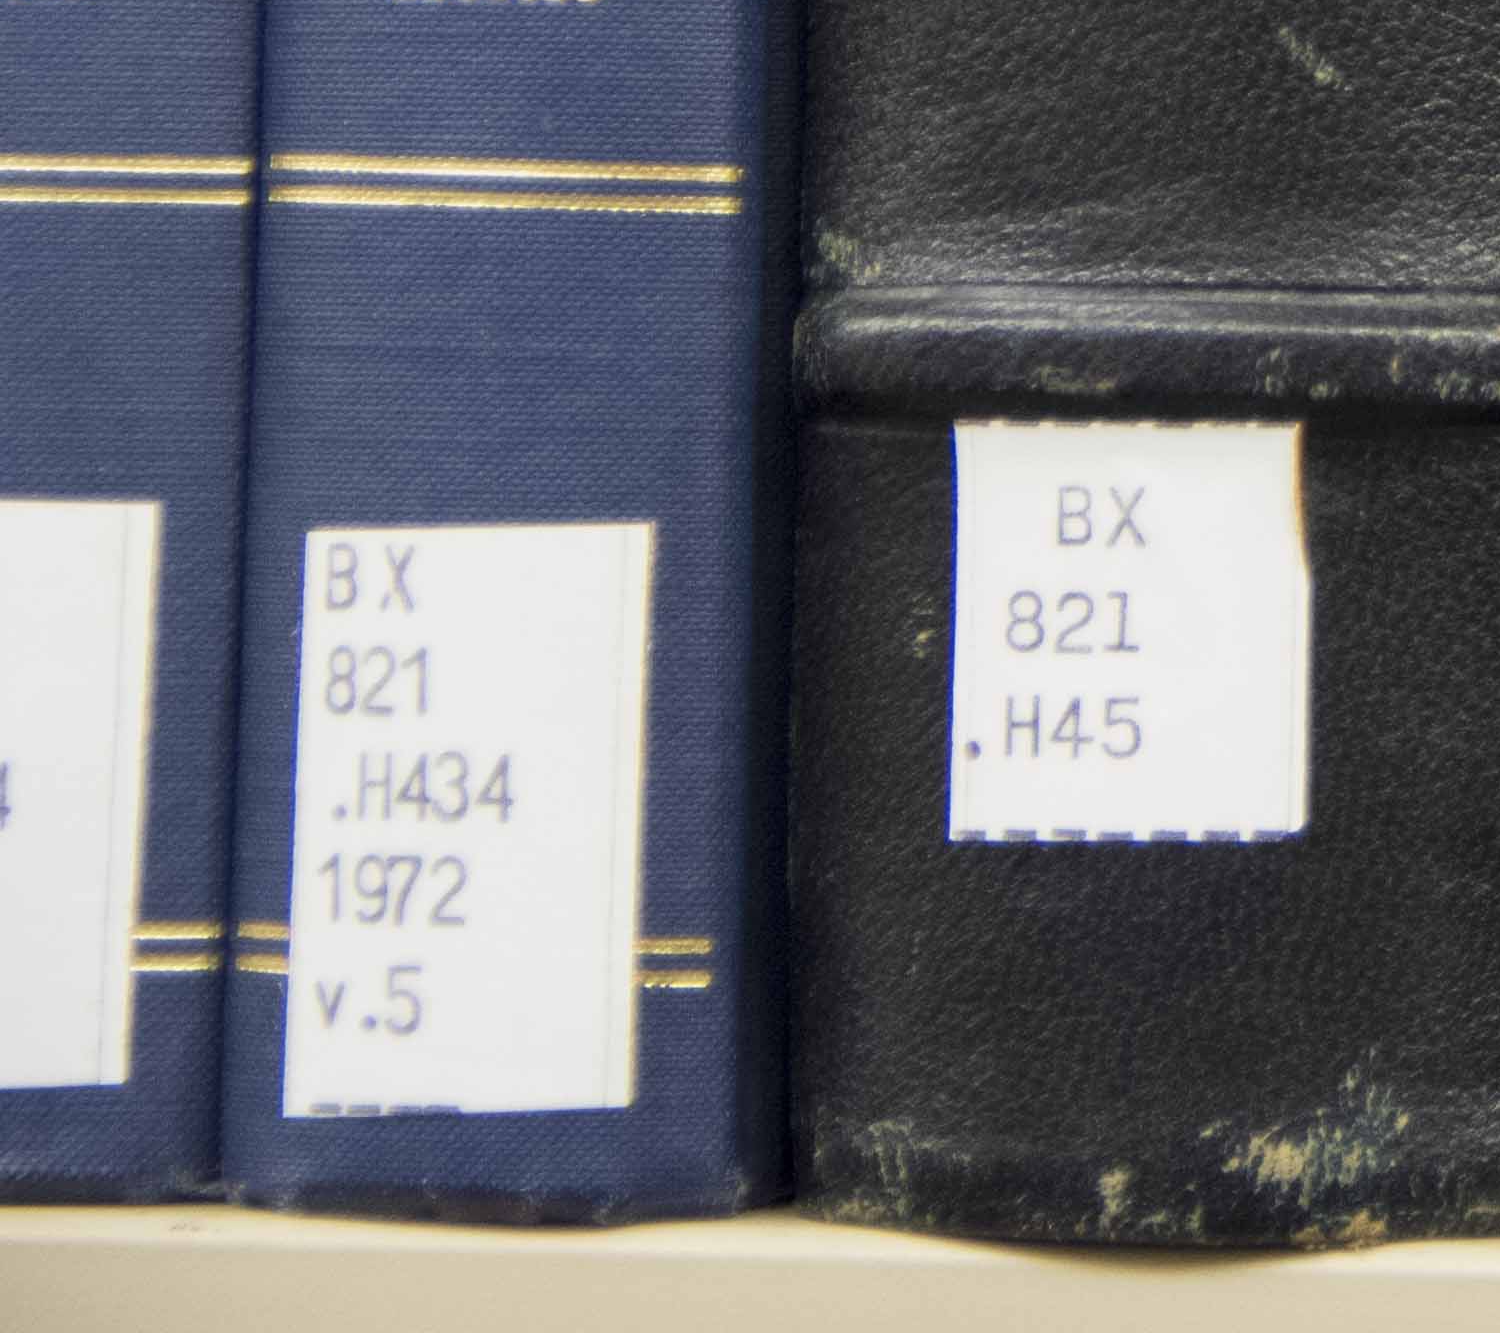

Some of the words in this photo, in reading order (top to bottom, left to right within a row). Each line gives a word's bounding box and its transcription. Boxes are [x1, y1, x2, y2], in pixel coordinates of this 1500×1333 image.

[1056, 483, 1150, 549] BX
[1004, 589, 1144, 657] 821
[322, 646, 433, 715] 821
[329, 753, 517, 826] .H434
[316, 856, 470, 929] 1972
